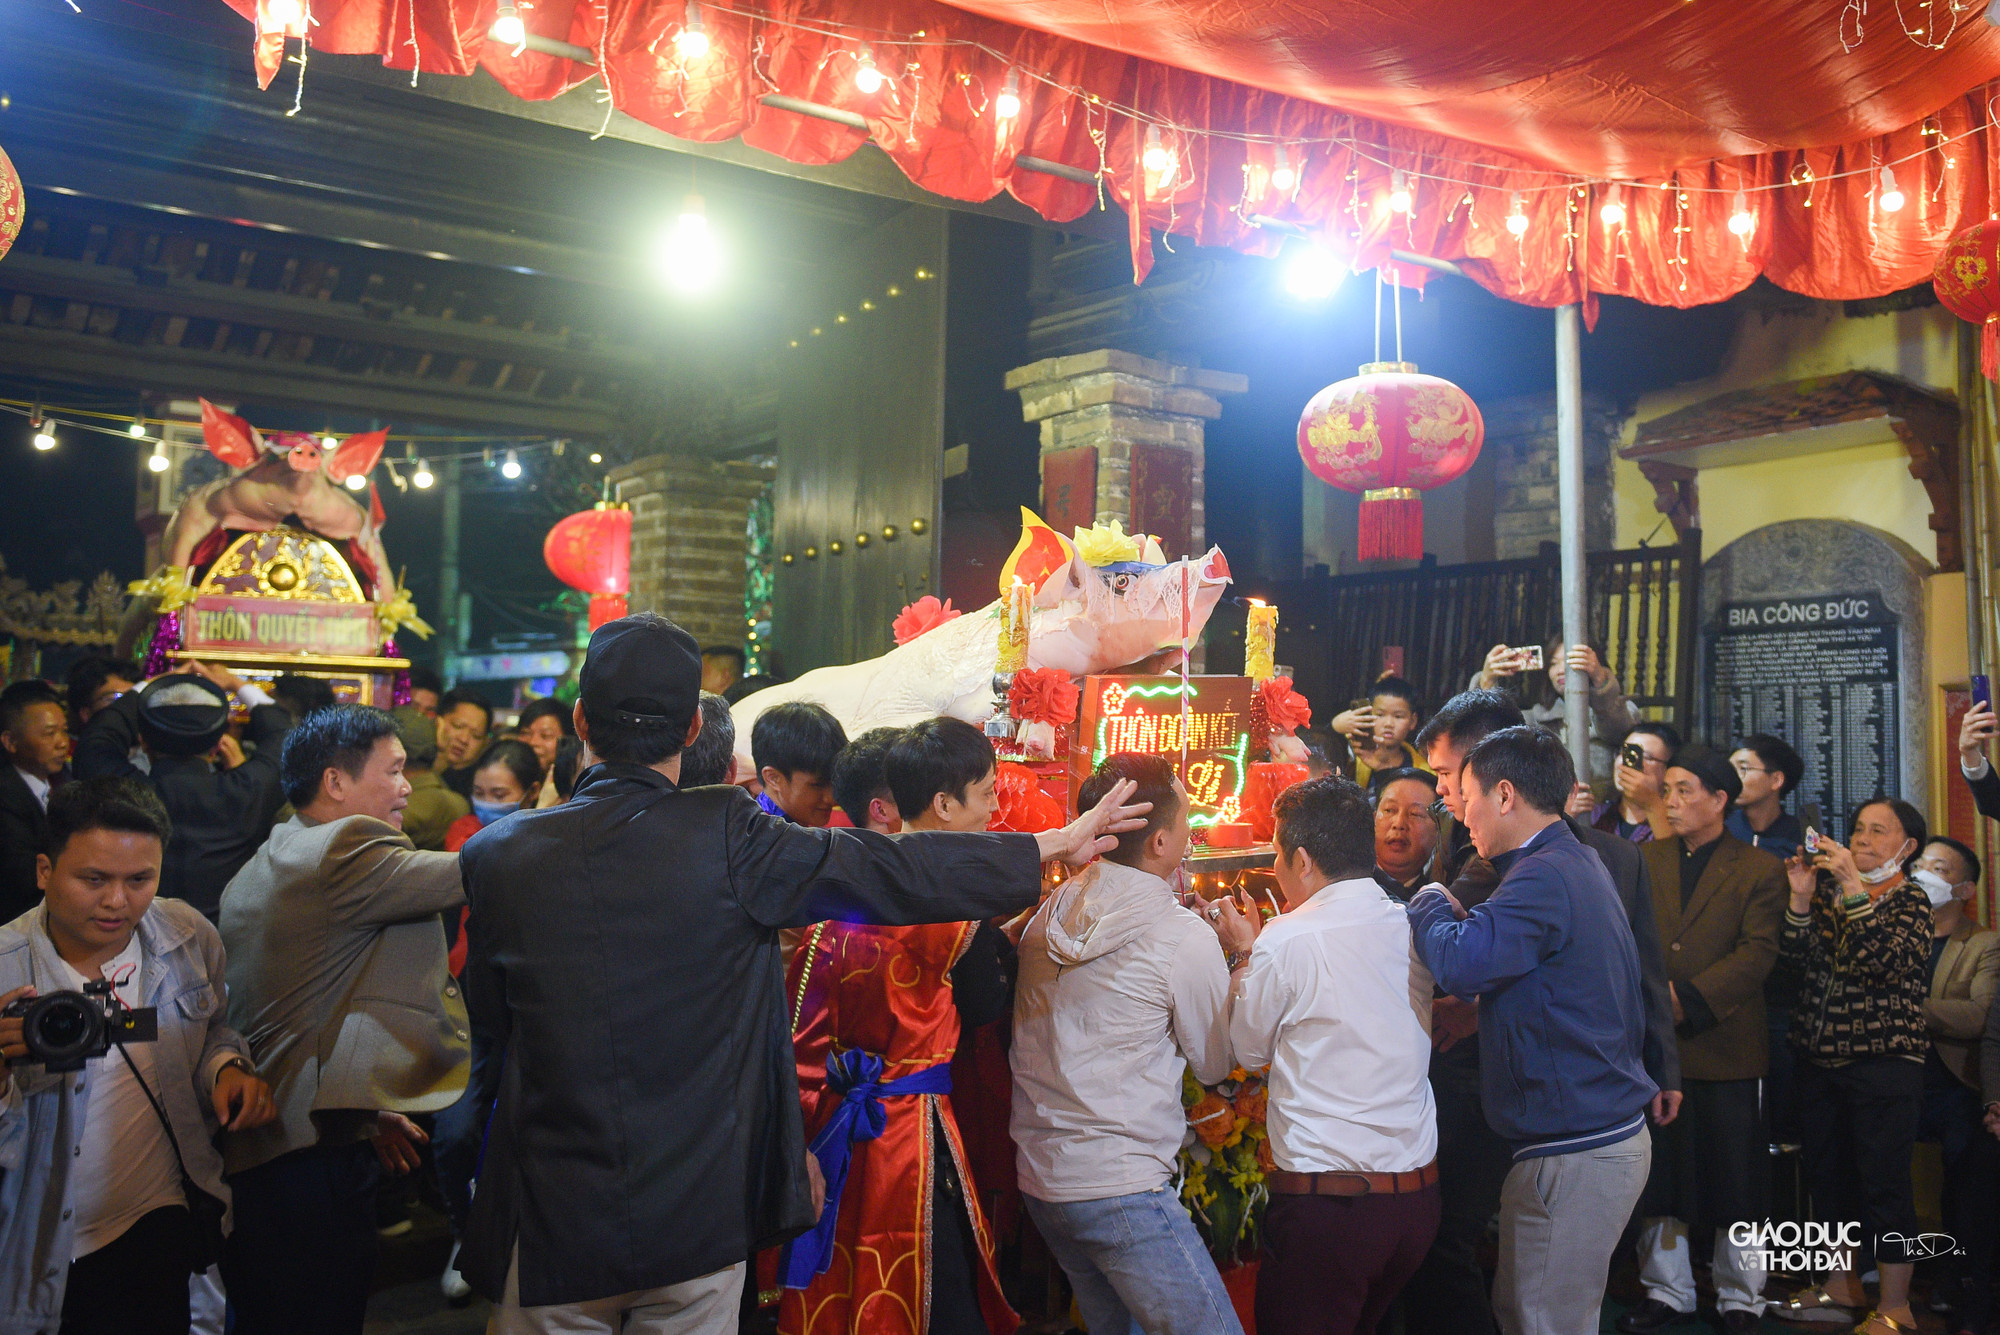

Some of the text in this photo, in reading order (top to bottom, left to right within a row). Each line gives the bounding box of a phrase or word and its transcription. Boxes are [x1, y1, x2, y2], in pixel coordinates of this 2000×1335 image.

[197, 605, 251, 642] THÔN
[257, 606, 319, 645] QUYẾT
[1729, 598, 1869, 626] BIA CÔNG ĐỨC
[1109, 707, 1158, 755] THÔN
[1209, 698, 1240, 749] KẾT
